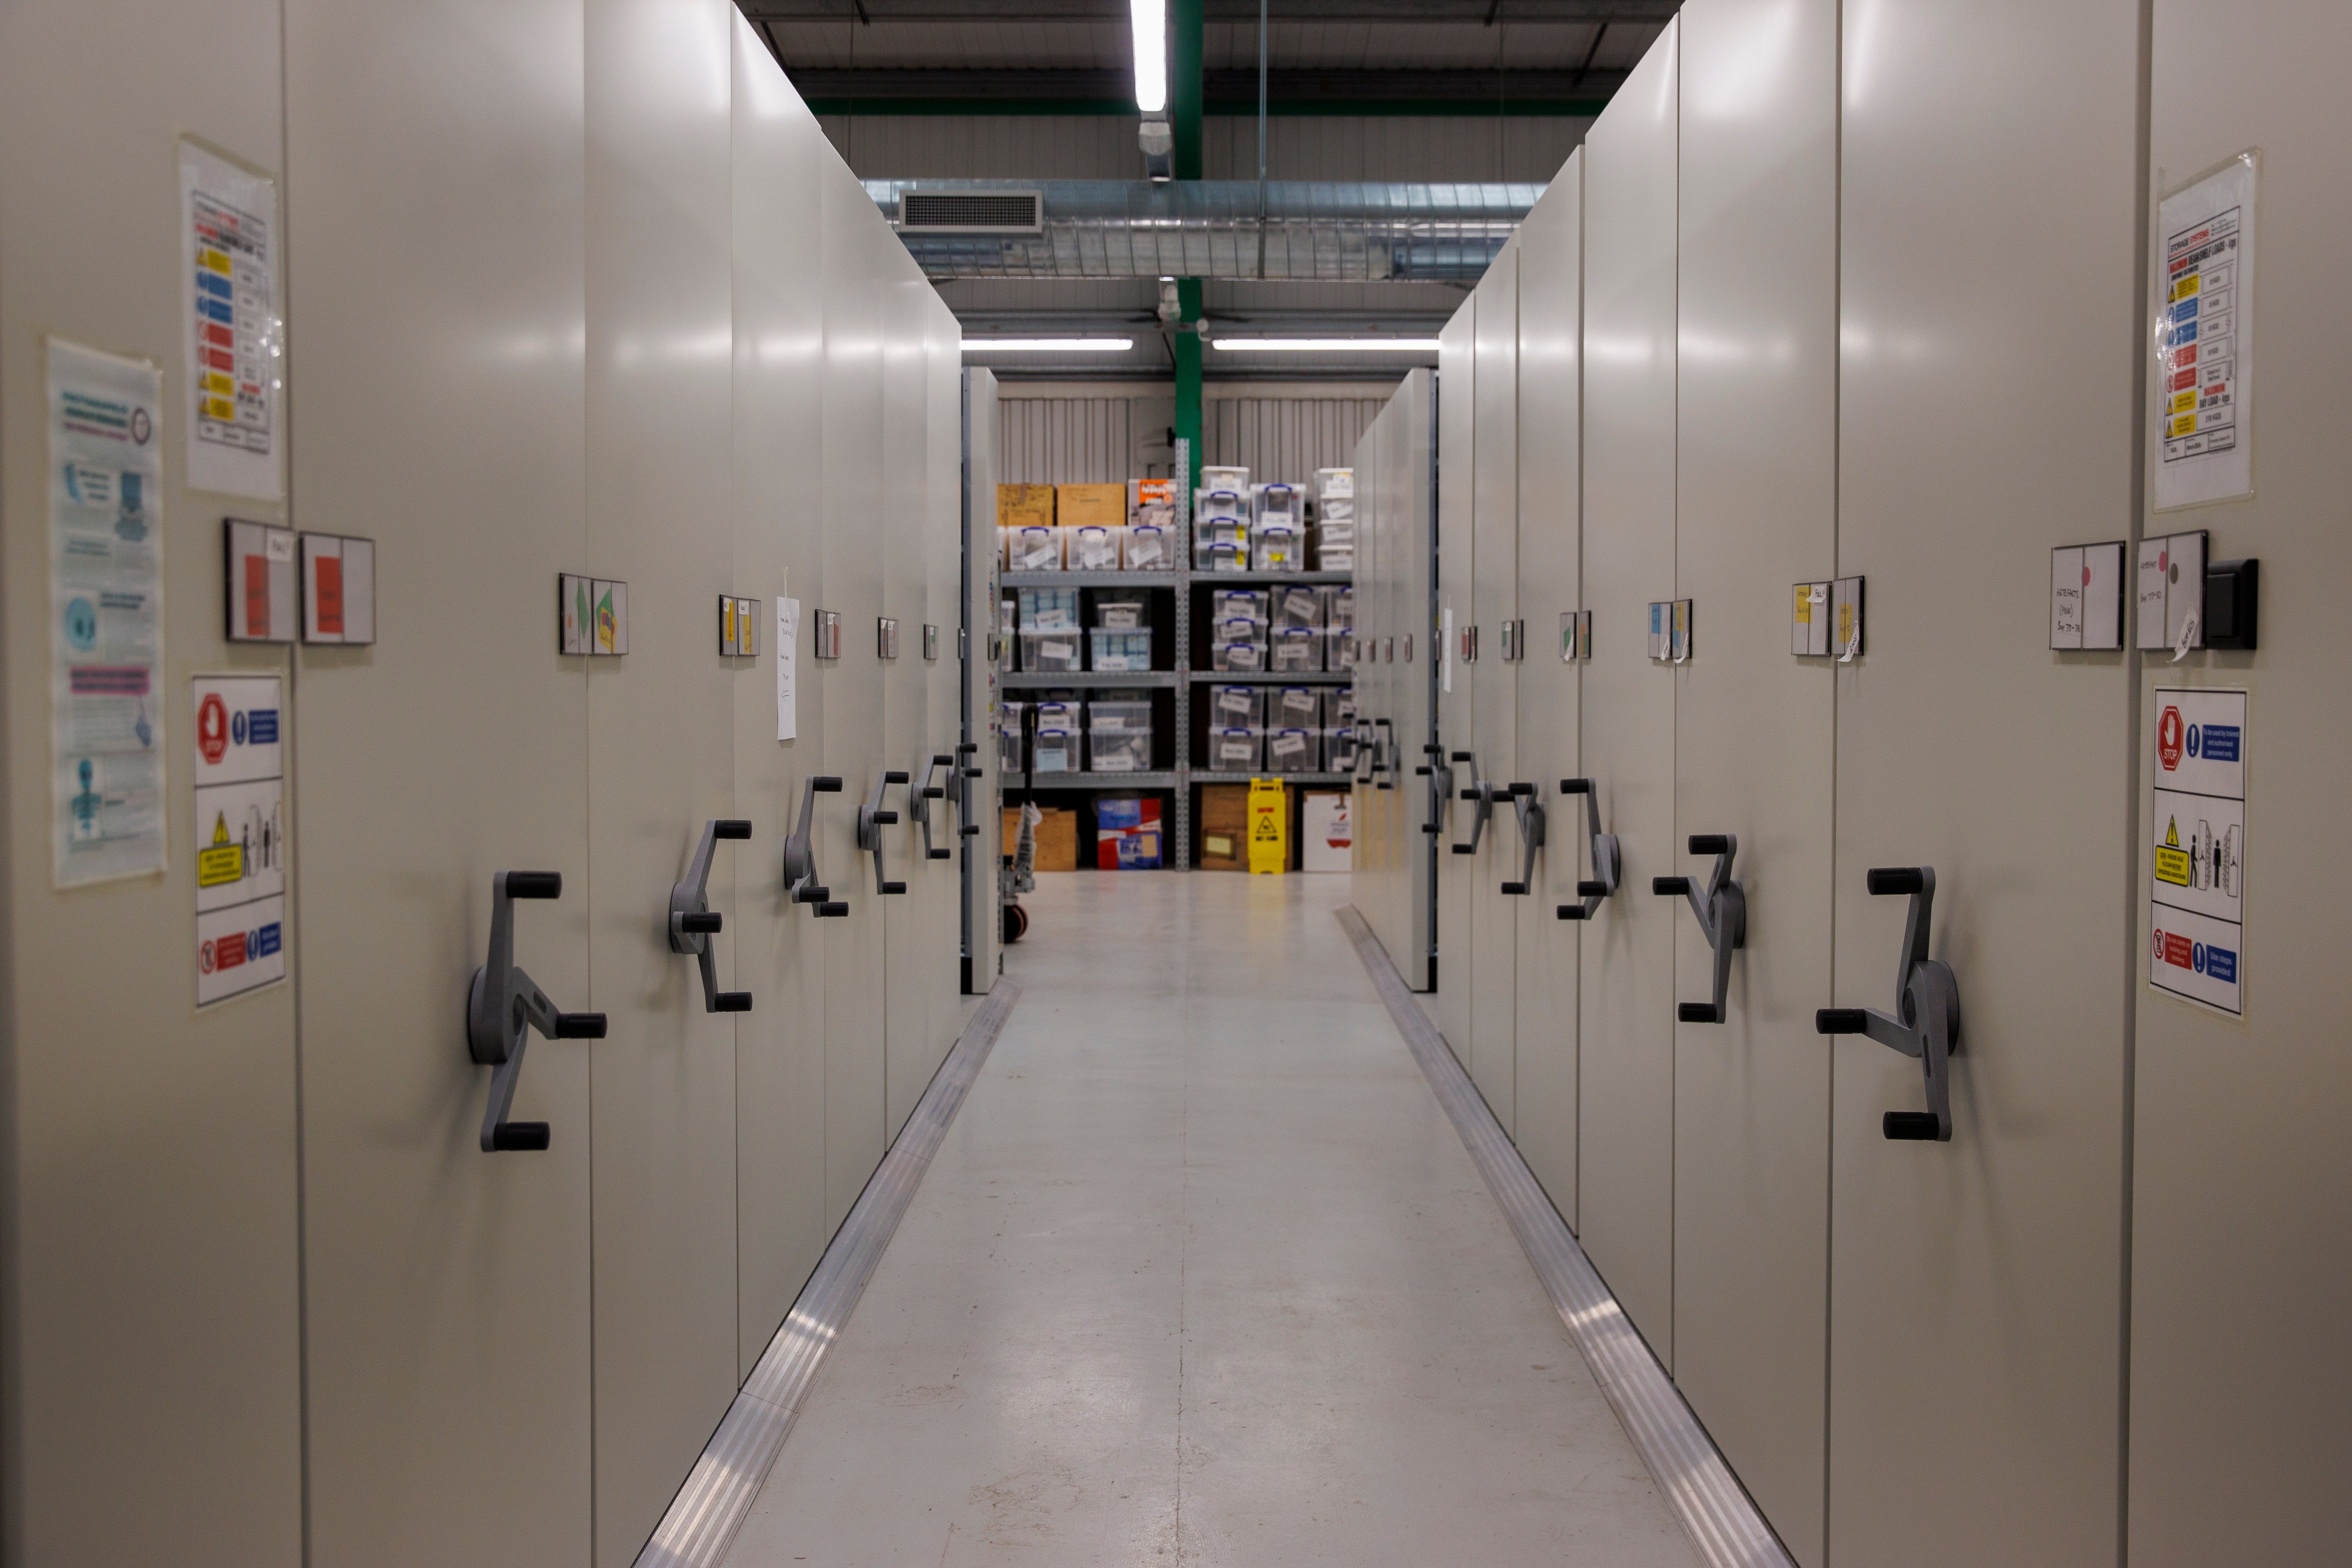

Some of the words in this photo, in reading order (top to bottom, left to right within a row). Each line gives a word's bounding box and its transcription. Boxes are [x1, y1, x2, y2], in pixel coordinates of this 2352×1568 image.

[2171, 238, 2189, 252] STORAGE
[2190, 228, 2209, 244] SYSTEMS
[2207, 395, 2218, 407] LOAD
[2212, 412, 2221, 420] KGS
[2164, 748, 2177, 760] STOP
[2169, 946, 2181, 955] racking
[2171, 954, 2185, 965] shelving
[2210, 951, 2218, 961] Use
[2219, 955, 2232, 965] steps
[2211, 965, 2231, 977] provided
